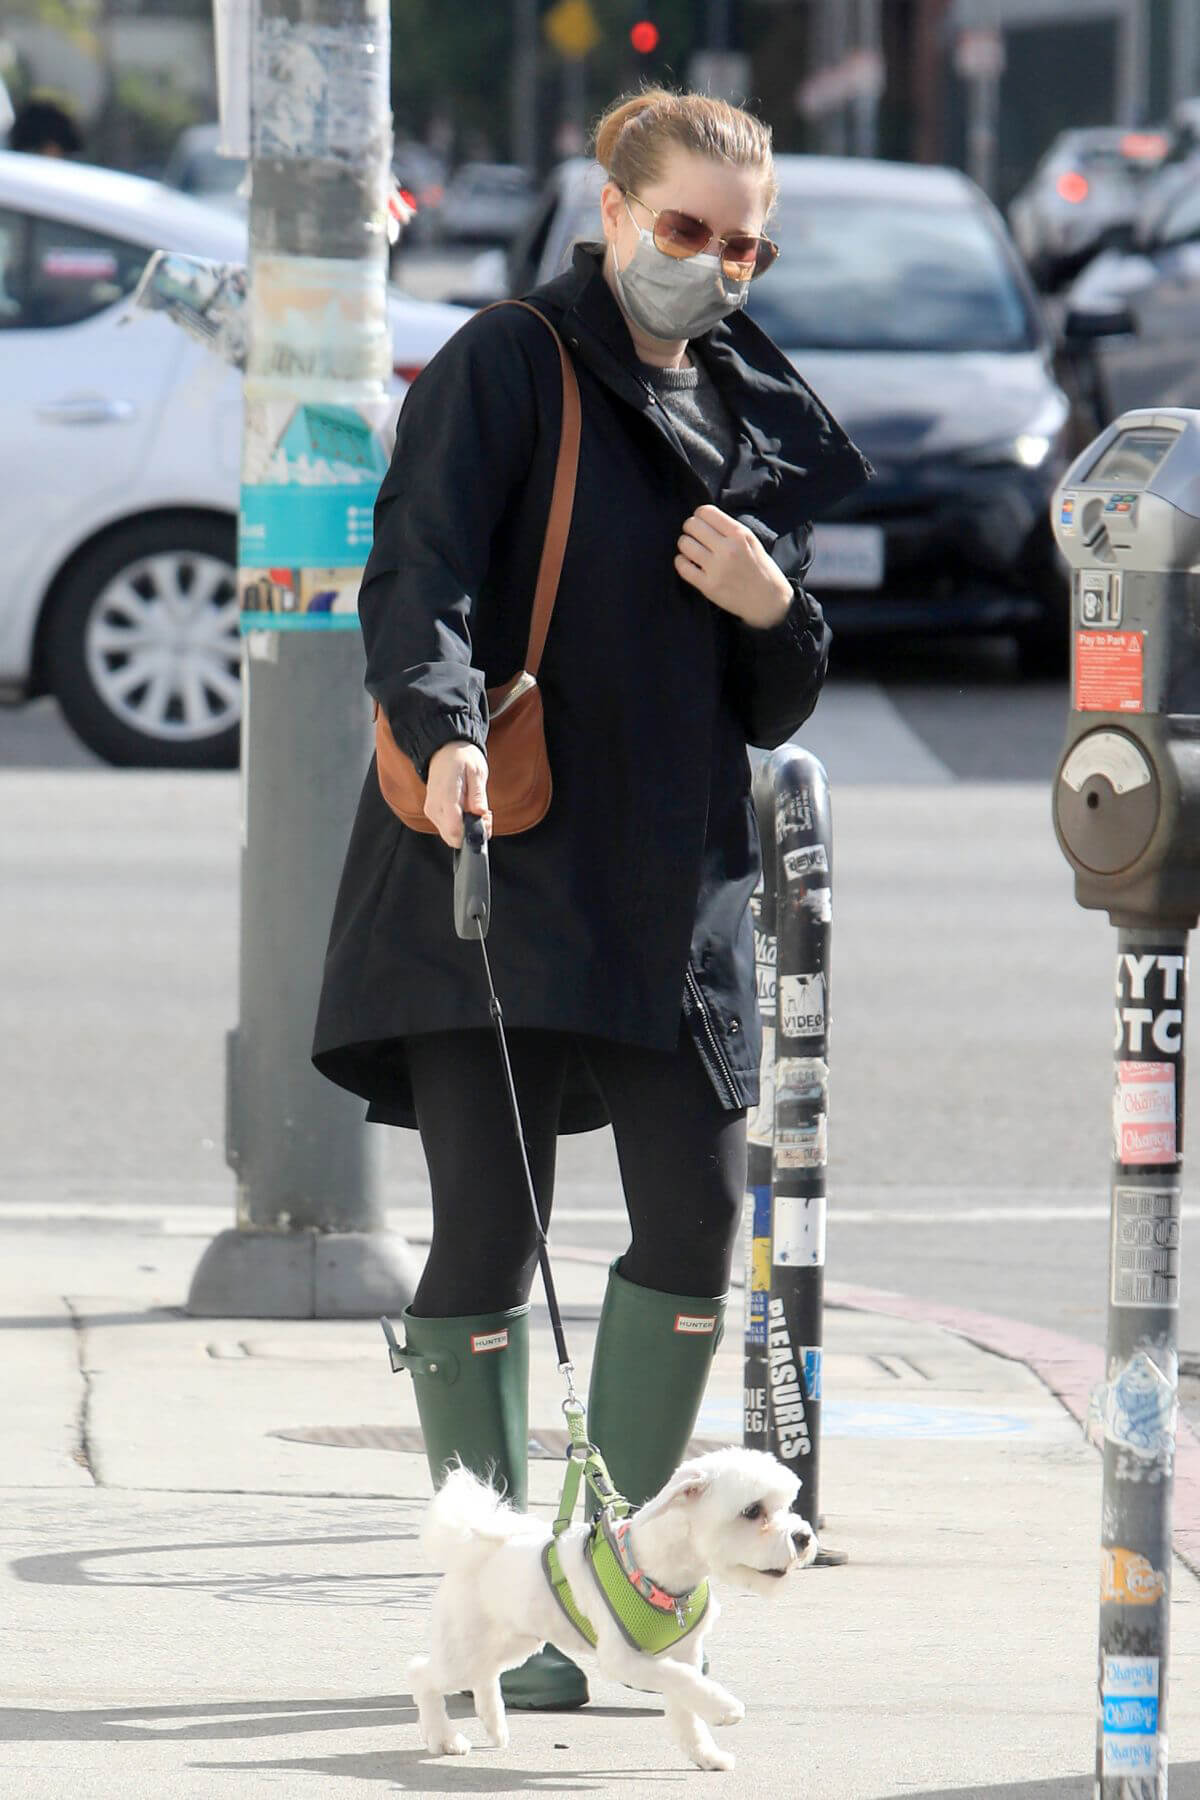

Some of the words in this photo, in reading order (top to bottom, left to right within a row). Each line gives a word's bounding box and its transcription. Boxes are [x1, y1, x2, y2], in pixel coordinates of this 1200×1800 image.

[1080, 634, 1094, 647] Pay
[1095, 636, 1104, 645] to
[1107, 634, 1125, 646] Park
[678, 1319, 714, 1330] HUNTER
[475, 1335, 507, 1347] HUNTER
[768, 1298, 811, 1459] PLEASURES
